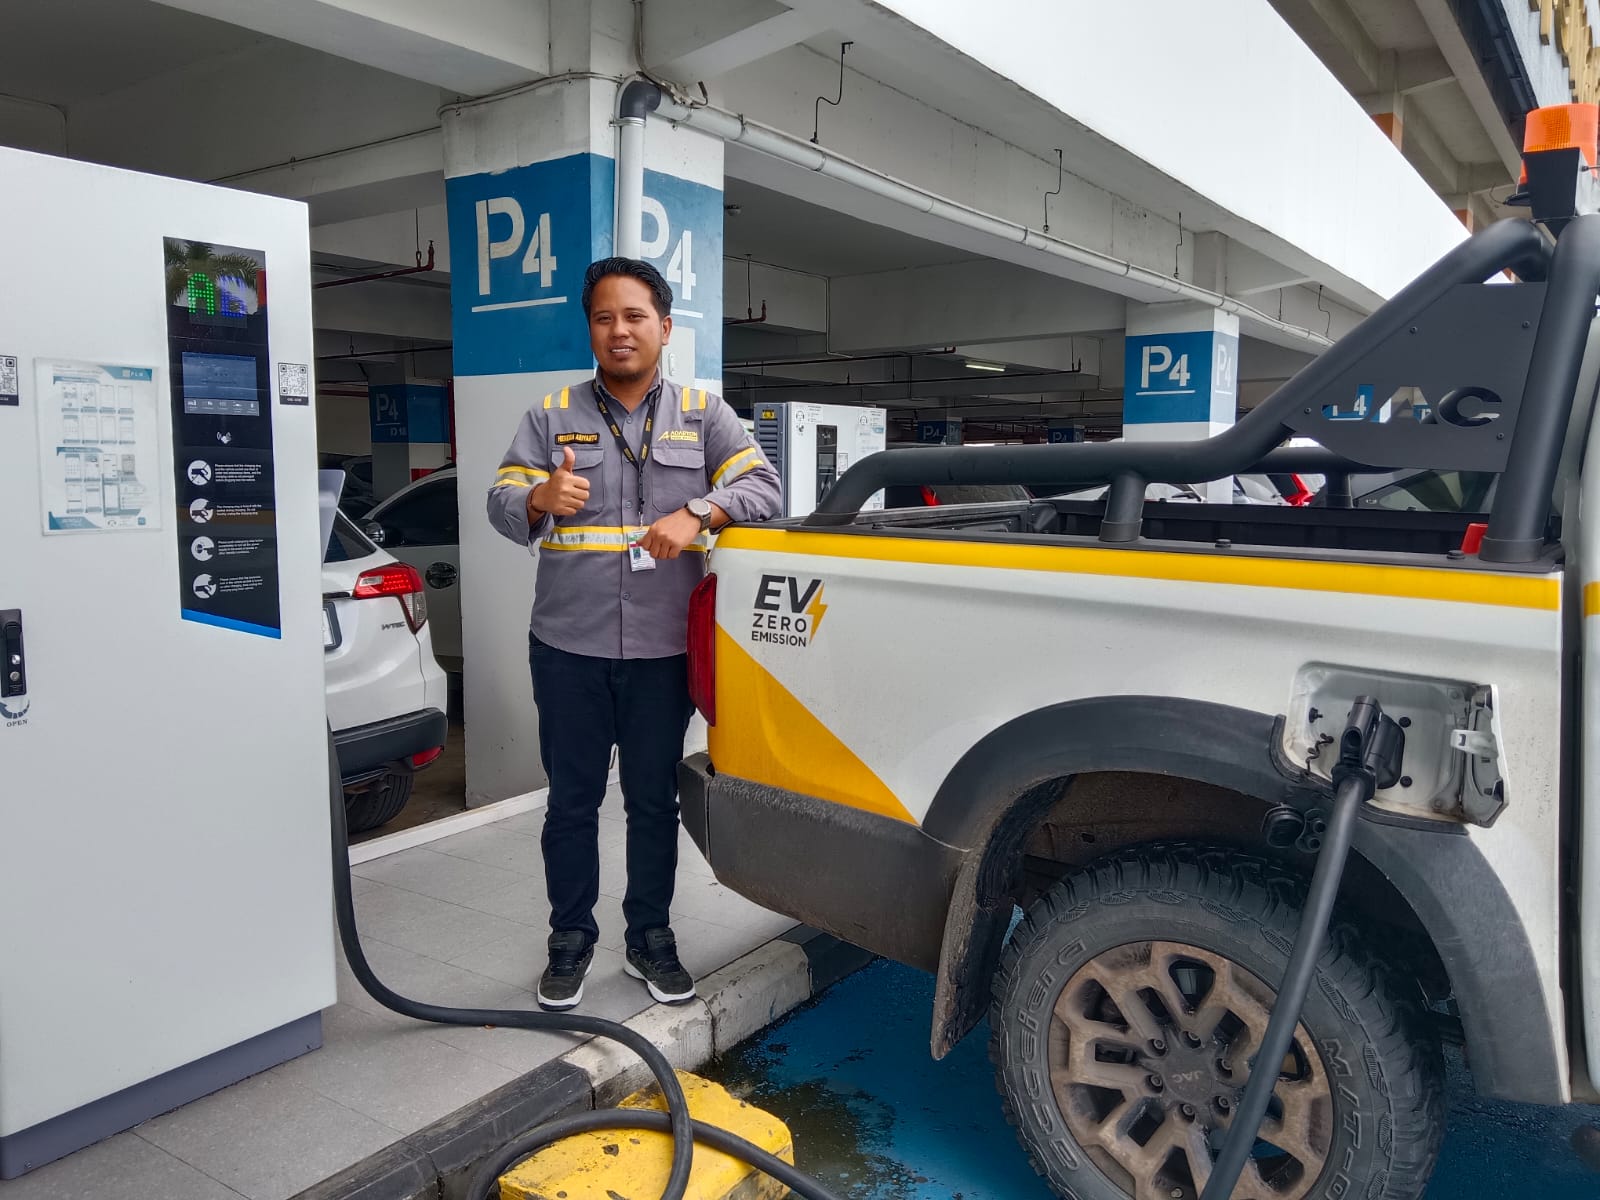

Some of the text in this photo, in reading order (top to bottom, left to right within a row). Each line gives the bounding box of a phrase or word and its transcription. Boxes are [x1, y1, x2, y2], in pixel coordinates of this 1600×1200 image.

[476, 196, 557, 296] P4
[1141, 345, 1191, 388] P4
[1216, 343, 1232, 388] P4
[375, 393, 399, 422] P4
[1321, 383, 1503, 428] JAC
[753, 574, 822, 614] EV
[751, 630, 807, 648] EMISSION
[752, 612, 807, 633] ZERO
[6, 718, 29, 729] OPEN
[1171, 1069, 1206, 1083] JAC
